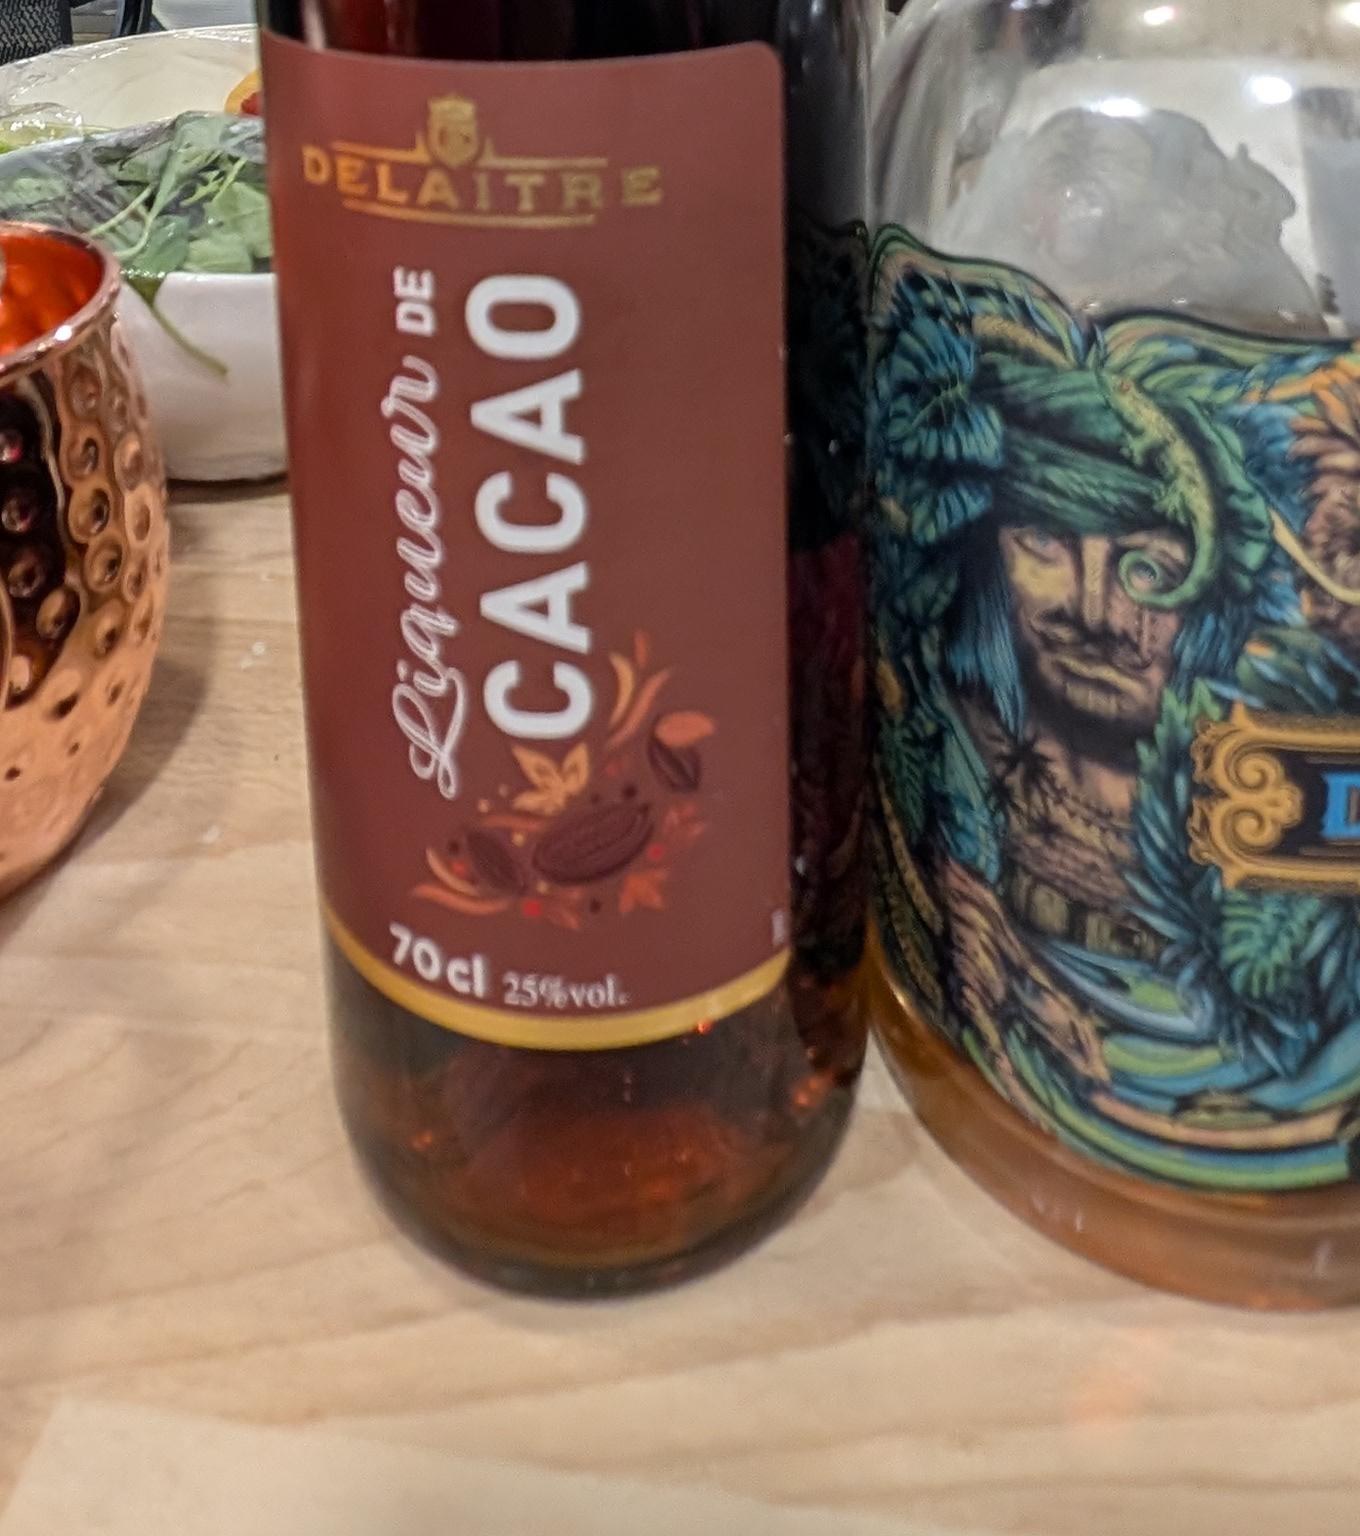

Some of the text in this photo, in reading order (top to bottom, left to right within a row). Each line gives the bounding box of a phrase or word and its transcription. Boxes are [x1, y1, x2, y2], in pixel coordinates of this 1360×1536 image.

[380, 265, 469, 800] Liqueur DE
[464, 273, 594, 741] CACAO
